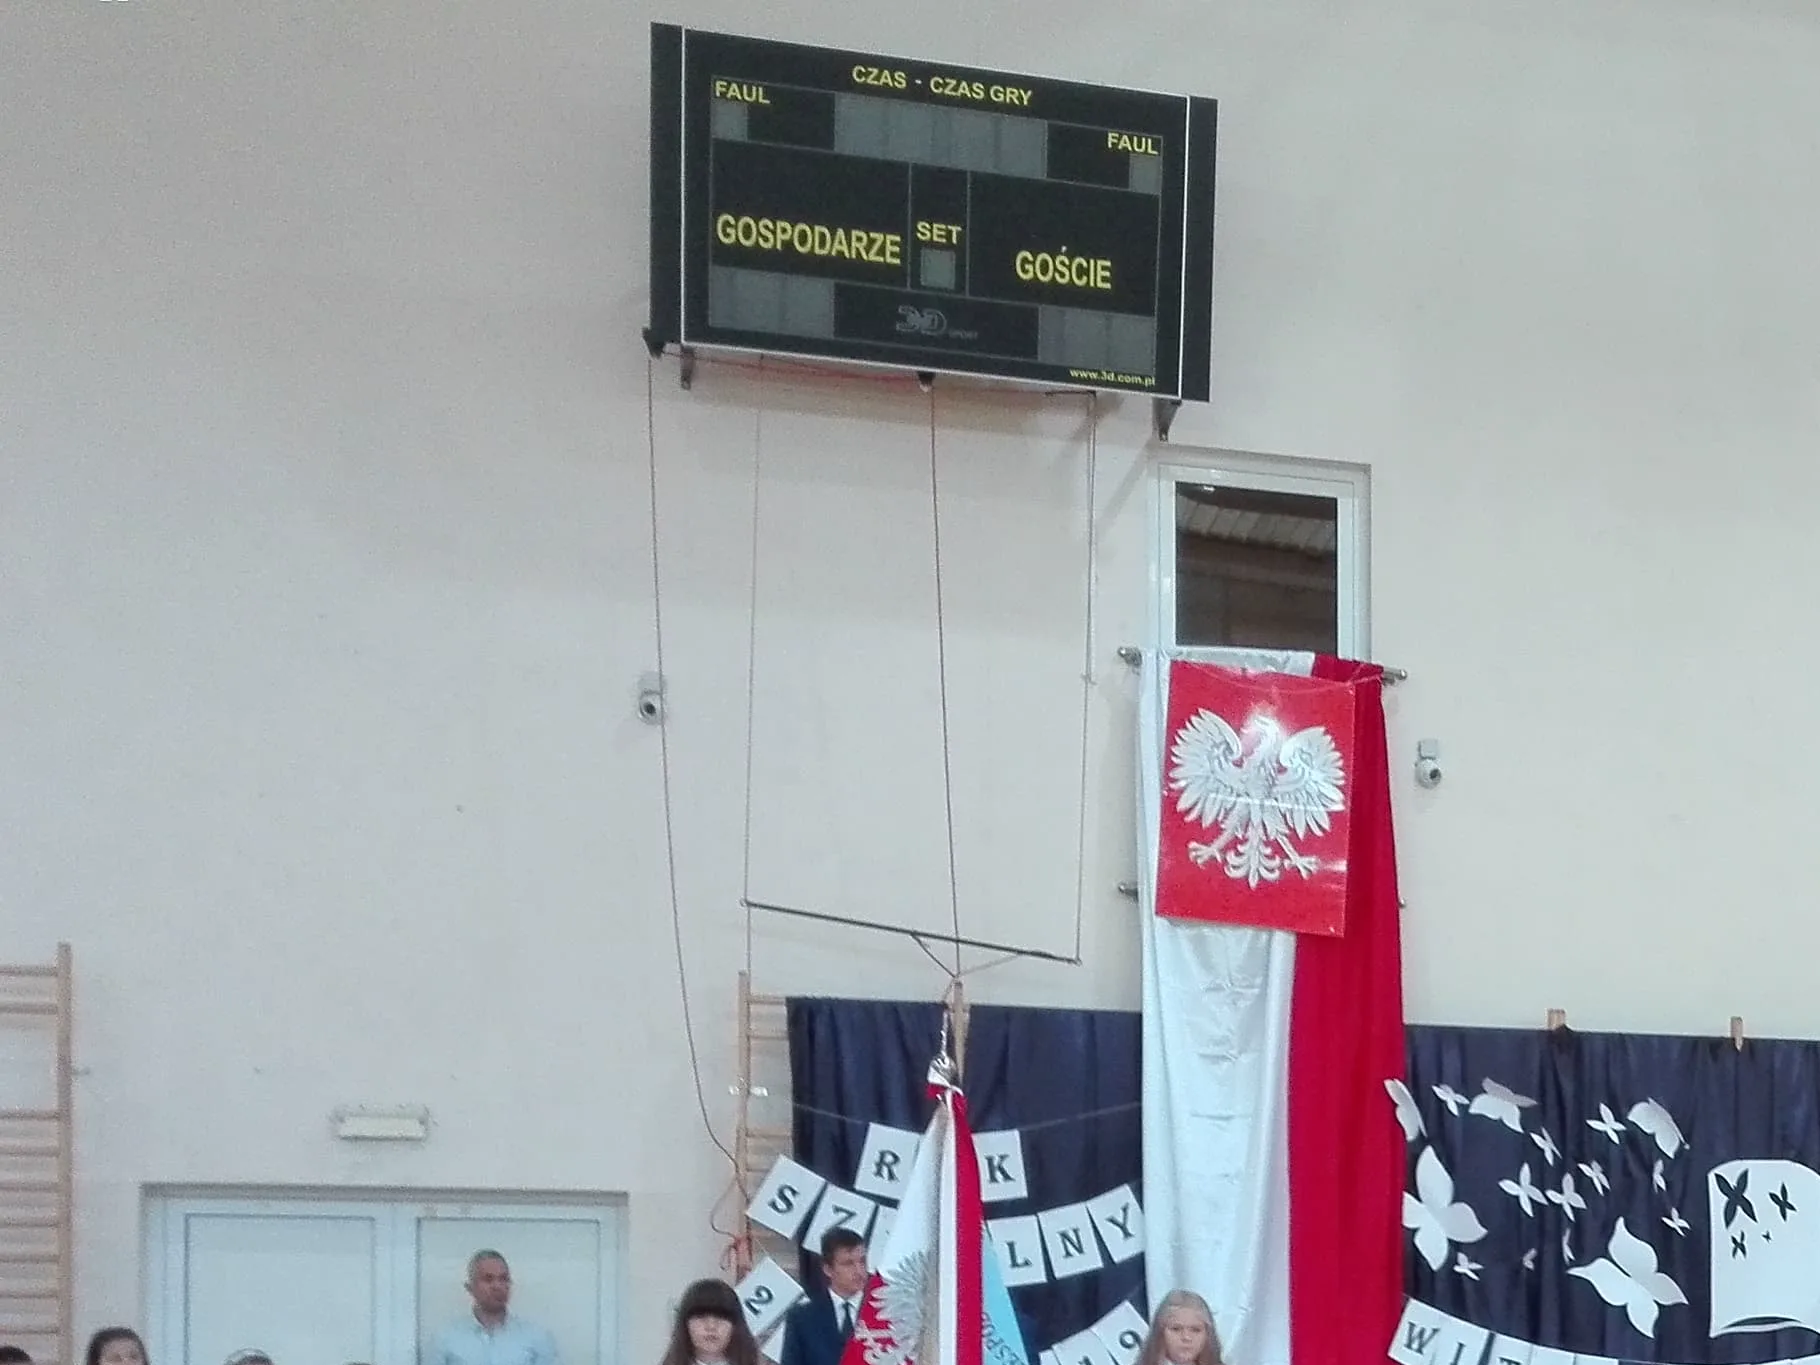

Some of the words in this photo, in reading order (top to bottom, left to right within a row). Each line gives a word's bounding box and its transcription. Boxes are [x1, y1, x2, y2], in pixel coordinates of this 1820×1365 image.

[715, 80, 771, 105] FAUL
[852, 65, 906, 89] CZAS
[929, 76, 985, 100] CZAS
[990, 85, 1032, 106] GRY
[1107, 132, 1159, 155] FAUL
[717, 214, 902, 266] GOSPODARZE
[916, 222, 962, 245] SET
[1015, 245, 1112, 290] GOŚCIE
[1069, 368, 1156, 388] www.3d.com.pl
[873, 1149, 1016, 1184] RK
